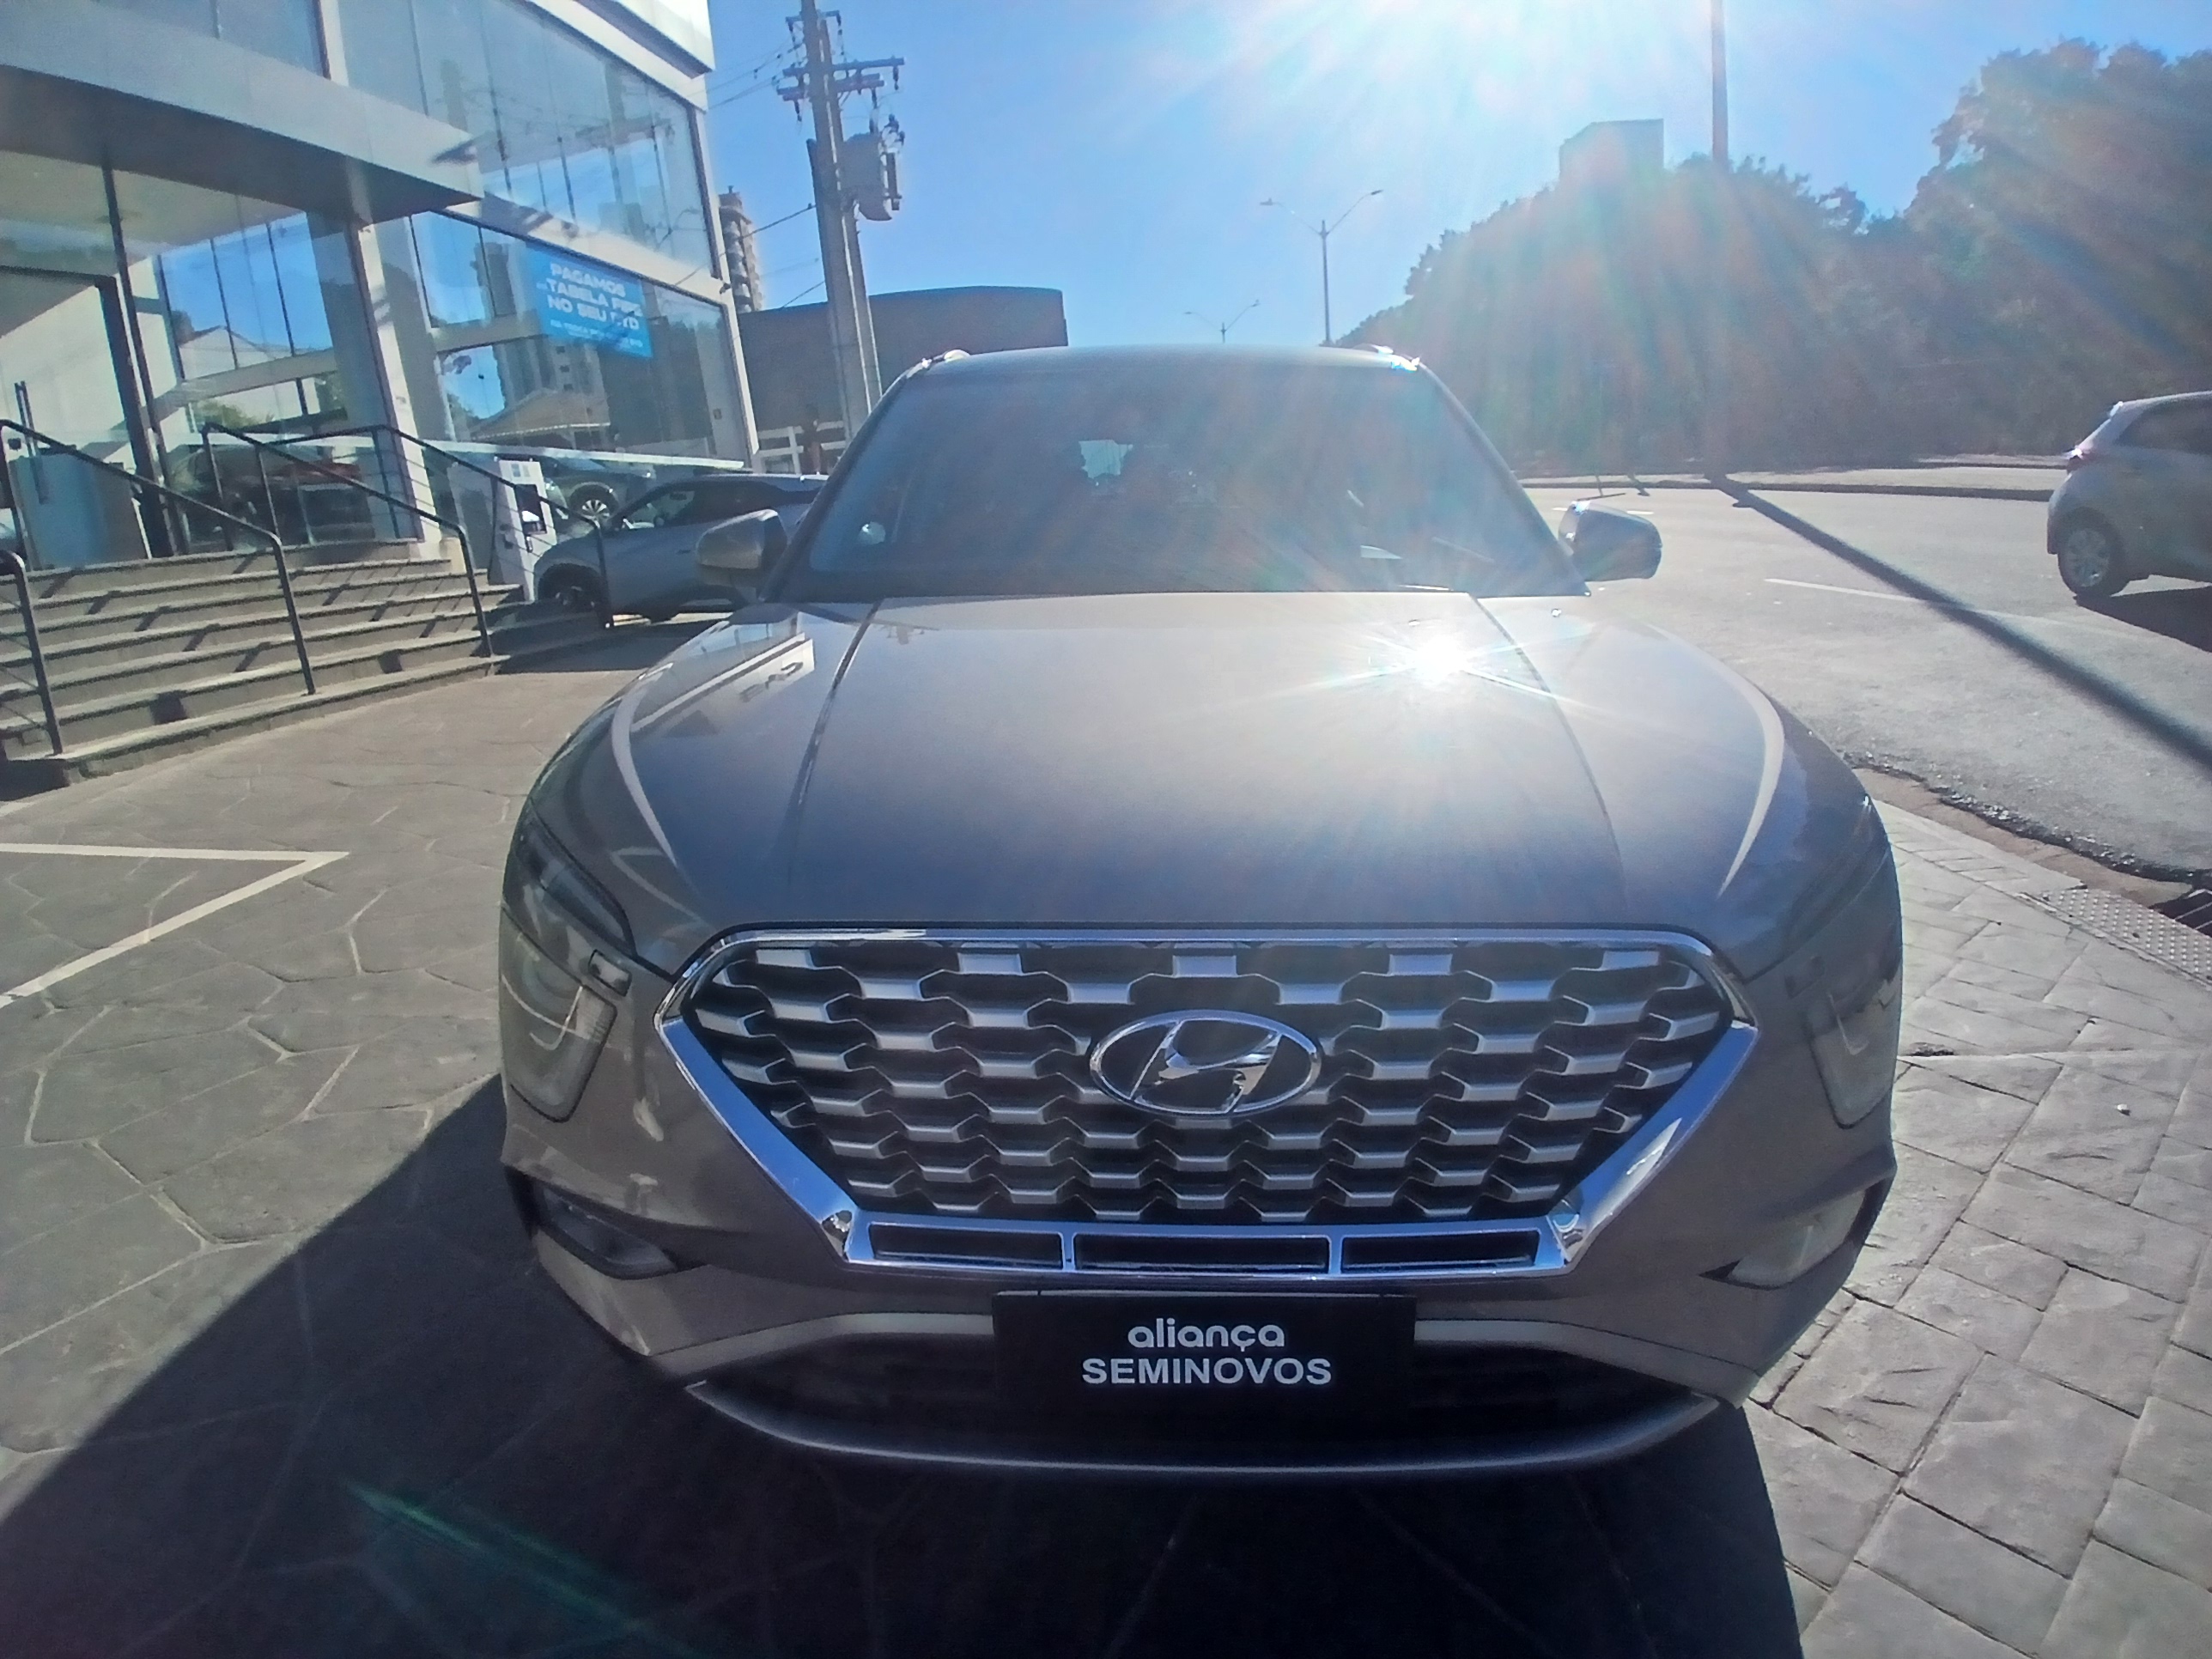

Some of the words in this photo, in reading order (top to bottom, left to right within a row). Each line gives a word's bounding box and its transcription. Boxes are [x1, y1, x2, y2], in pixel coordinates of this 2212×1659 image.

[546, 277, 609, 307] TABELA
[550, 263, 626, 298] PAGAMOS
[547, 295, 574, 313] NO
[1127, 1317, 1285, 1352] aliança
[1082, 1357, 1332, 1385] SEMINOVOS
